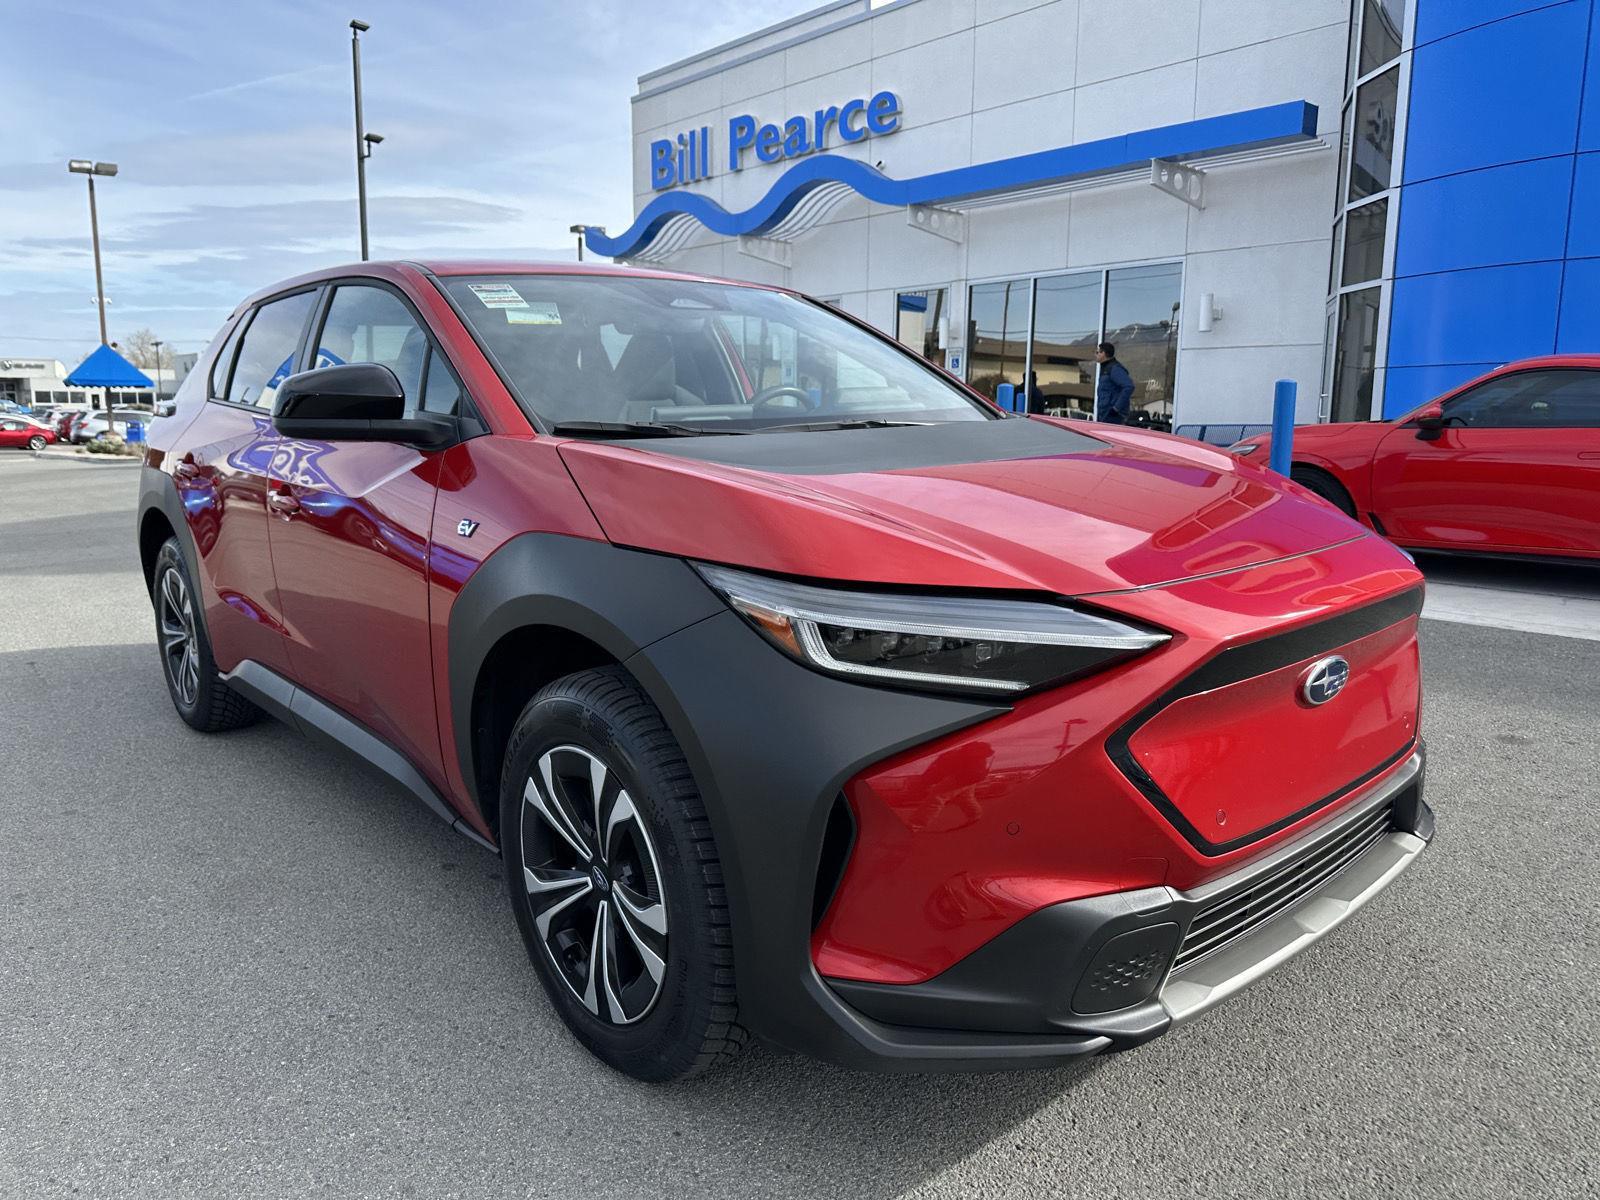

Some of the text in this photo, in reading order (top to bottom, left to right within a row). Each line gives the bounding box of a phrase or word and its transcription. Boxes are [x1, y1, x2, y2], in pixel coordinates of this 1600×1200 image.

[650, 91, 900, 190] Bill Pearce
[457, 519, 478, 536] EV
